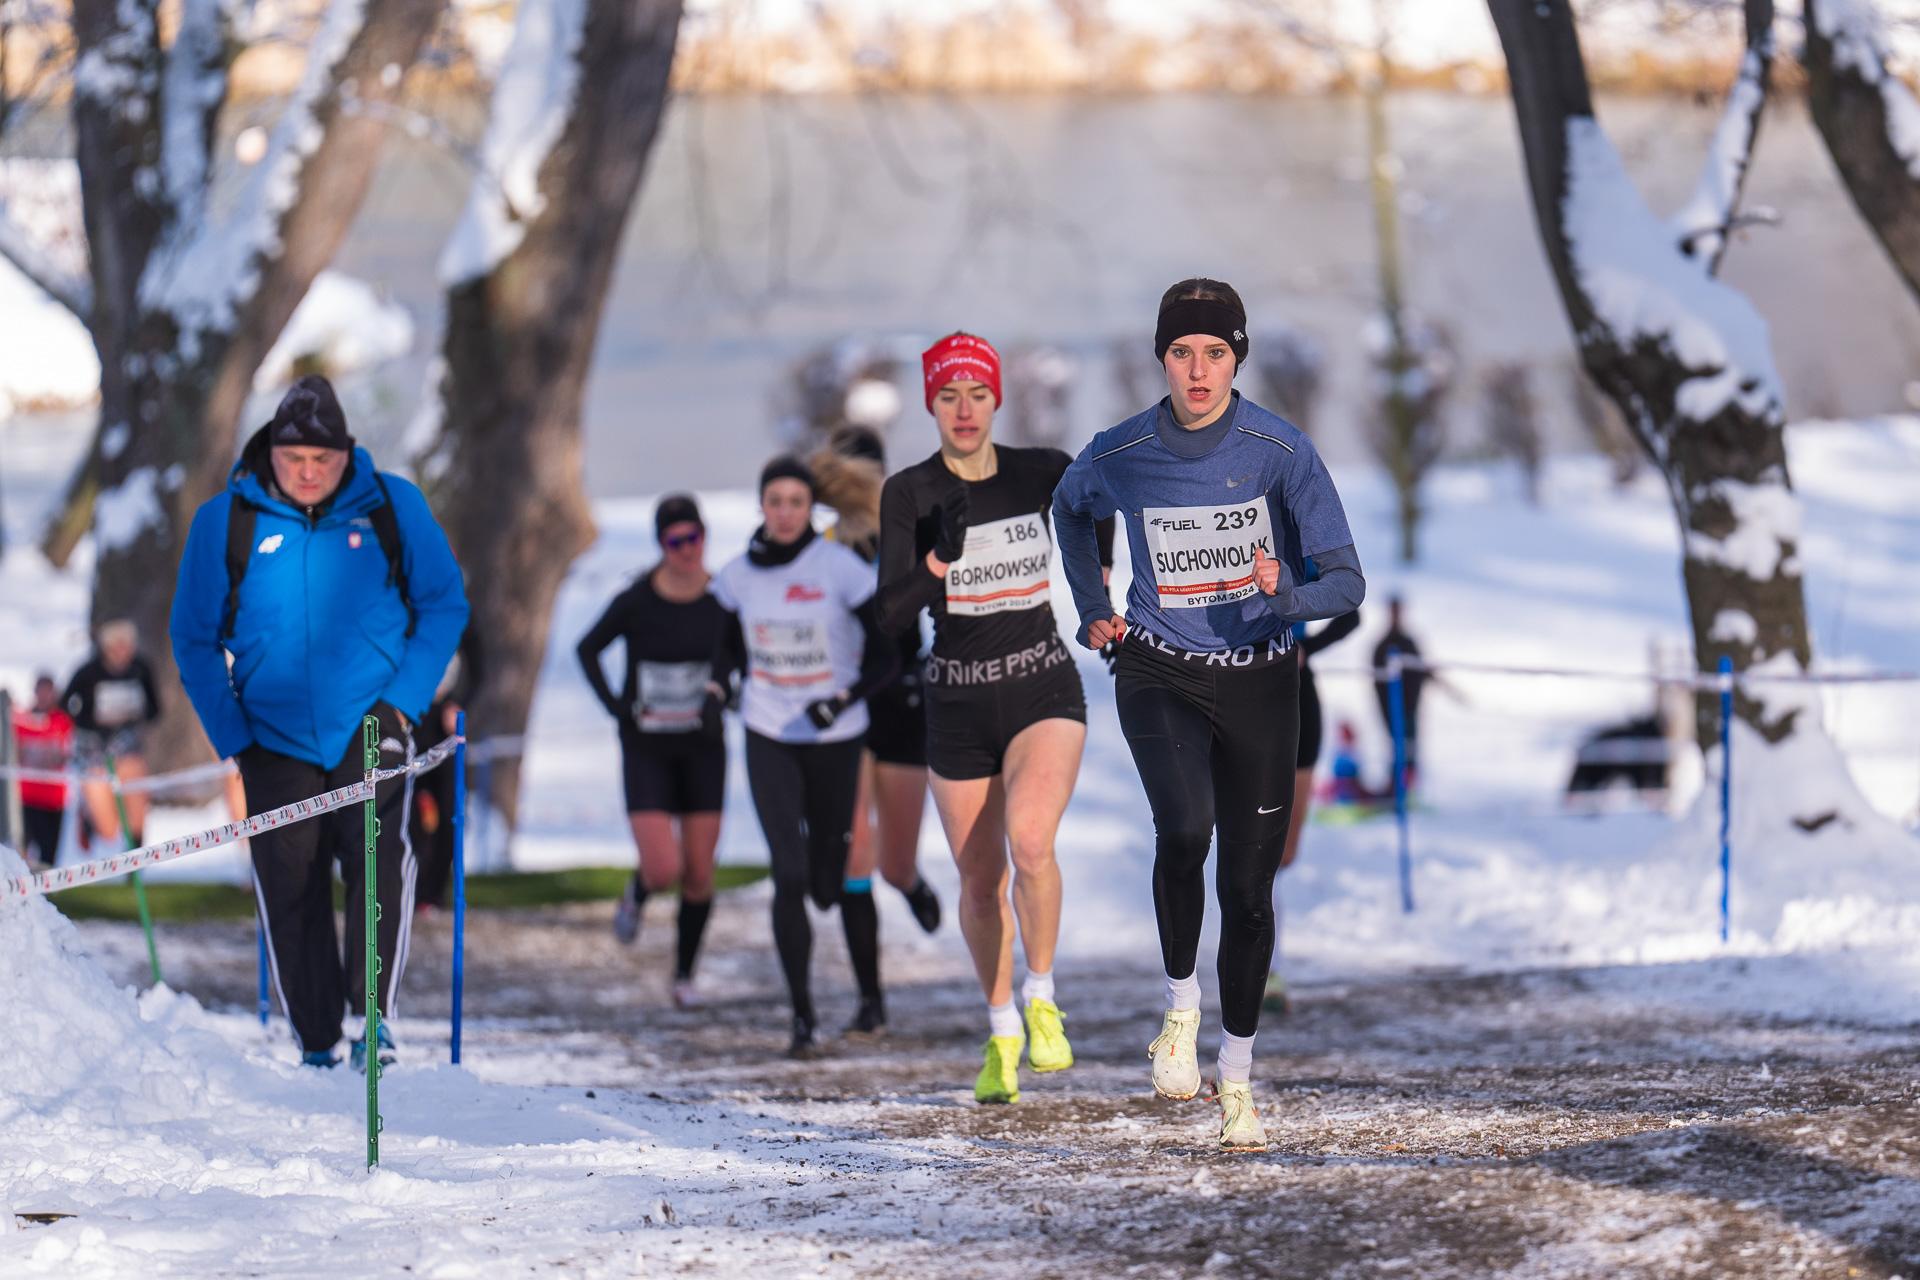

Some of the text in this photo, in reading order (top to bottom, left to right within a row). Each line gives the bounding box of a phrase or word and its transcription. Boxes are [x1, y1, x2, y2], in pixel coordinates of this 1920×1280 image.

[1163, 520, 1202, 532] FUEL
[1213, 507, 1258, 531] 239
[1004, 522, 1038, 544] 186
[1156, 536, 1270, 573] SUCHOWOLAK
[951, 553, 1048, 586] BORKOWSKA
[1187, 585, 1255, 606] BYTOM 2024
[1132, 623, 1177, 656] IKE
[946, 658, 1003, 686] NIKE
